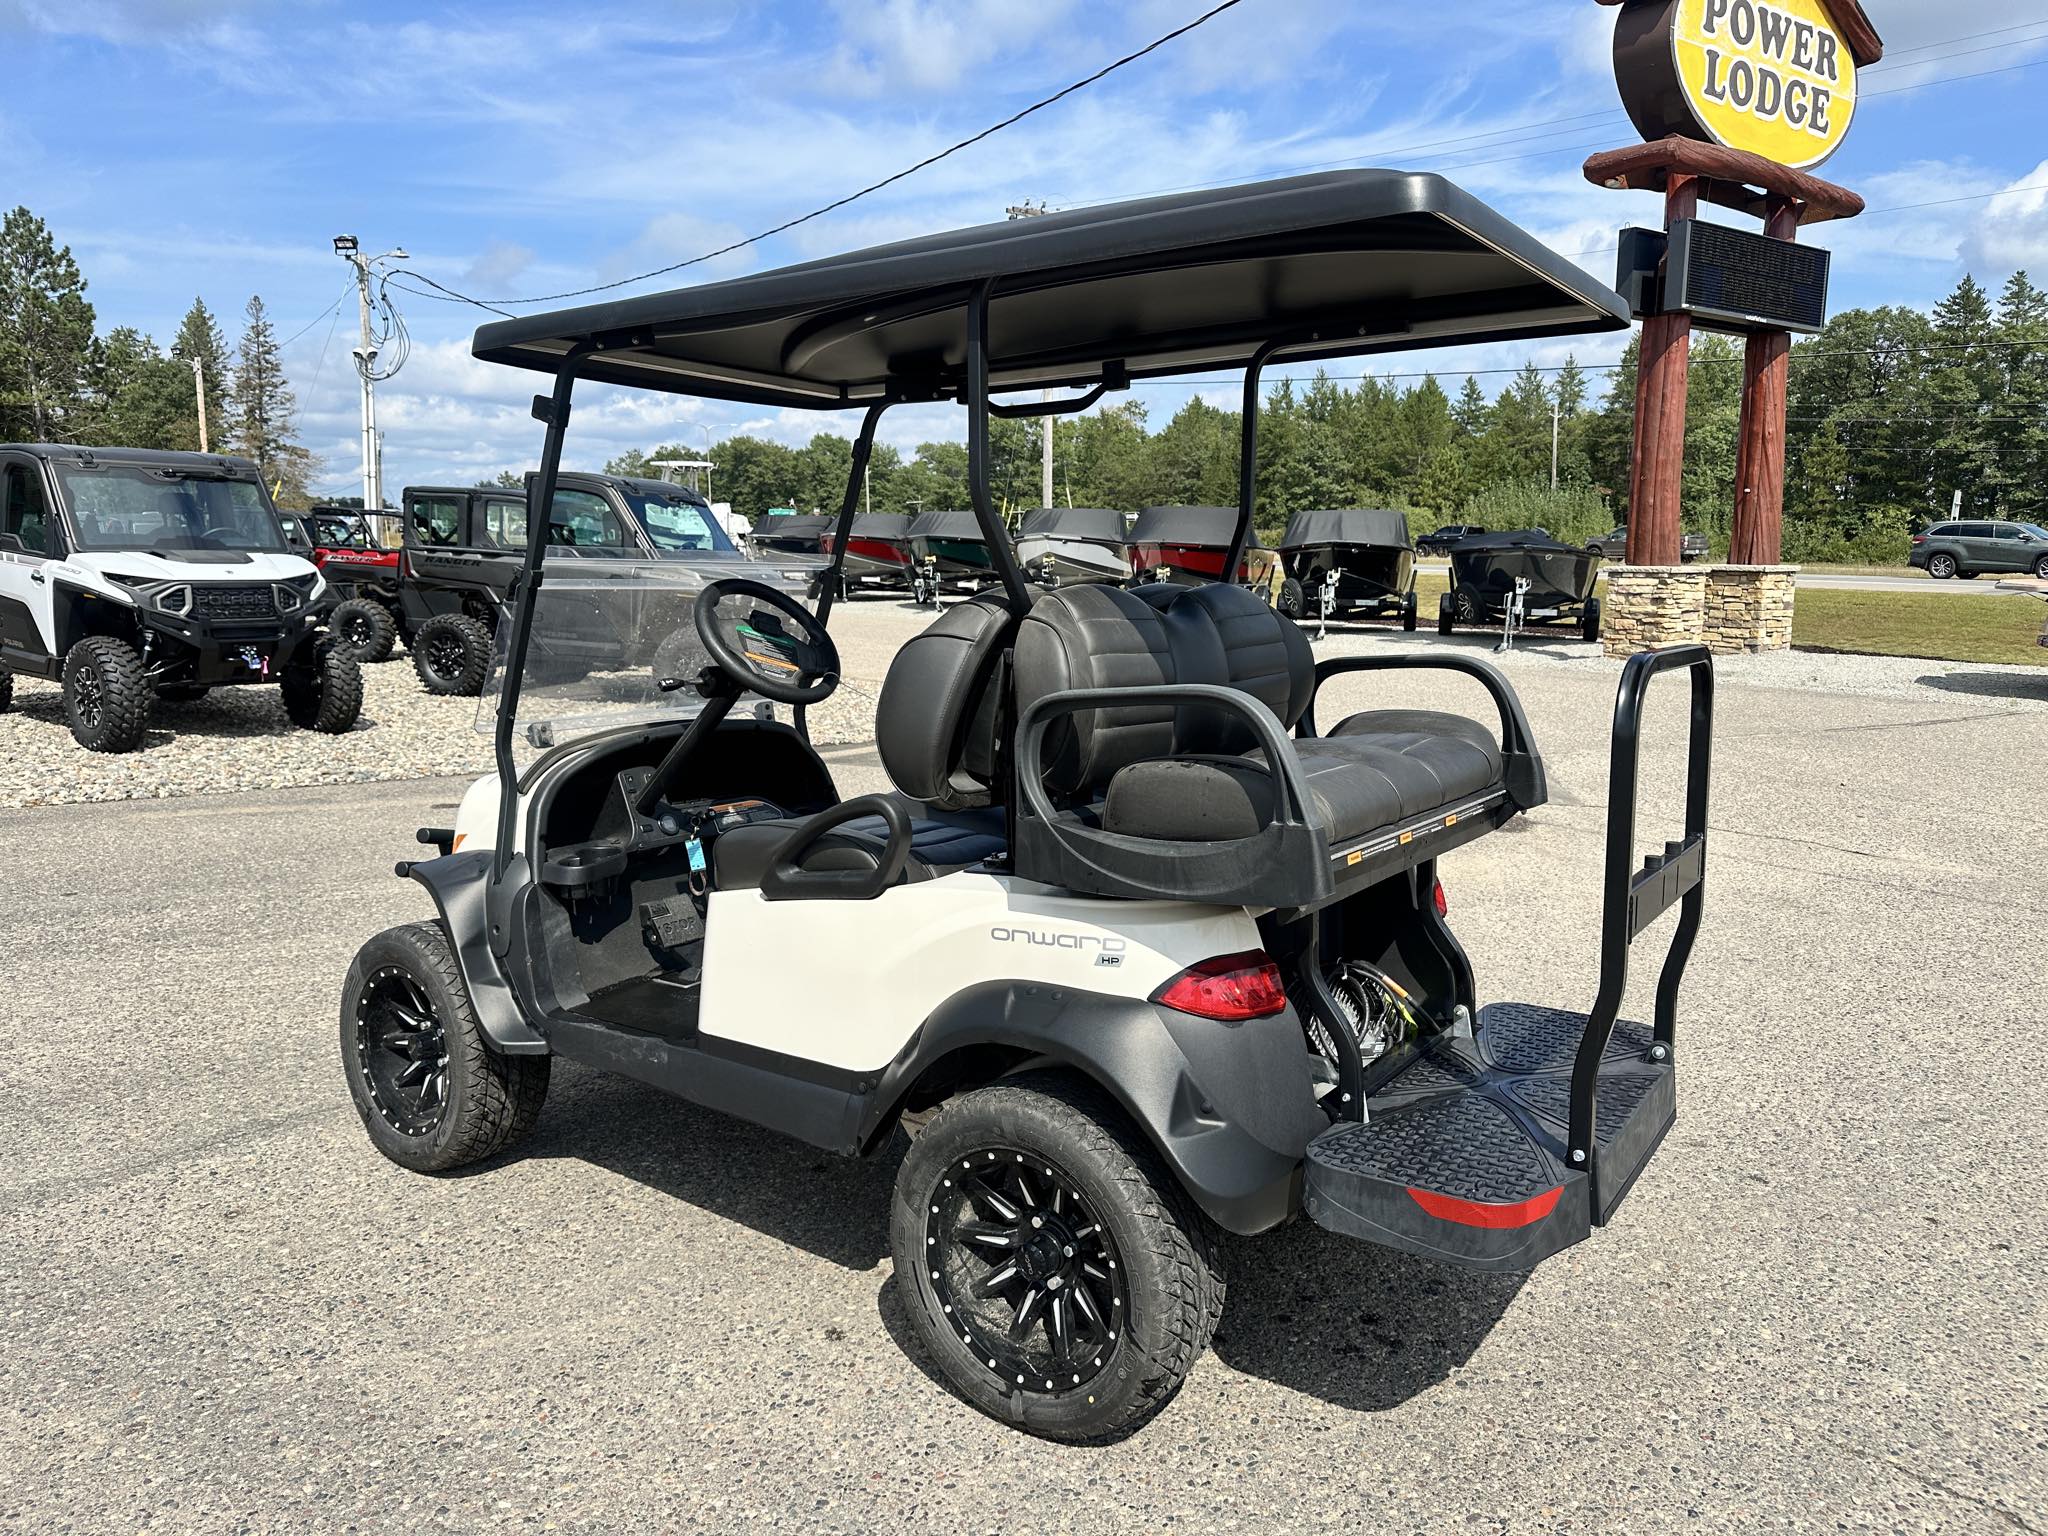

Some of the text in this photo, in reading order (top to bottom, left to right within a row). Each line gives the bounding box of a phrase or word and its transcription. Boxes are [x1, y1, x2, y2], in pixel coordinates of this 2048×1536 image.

[1703, 0, 1837, 81] POWER
[1704, 49, 1830, 134] LODGE
[424, 556, 482, 567] RANGER
[196, 594, 270, 605] POLARIS
[663, 916, 697, 935] STOP
[1101, 956, 1120, 965] HP
